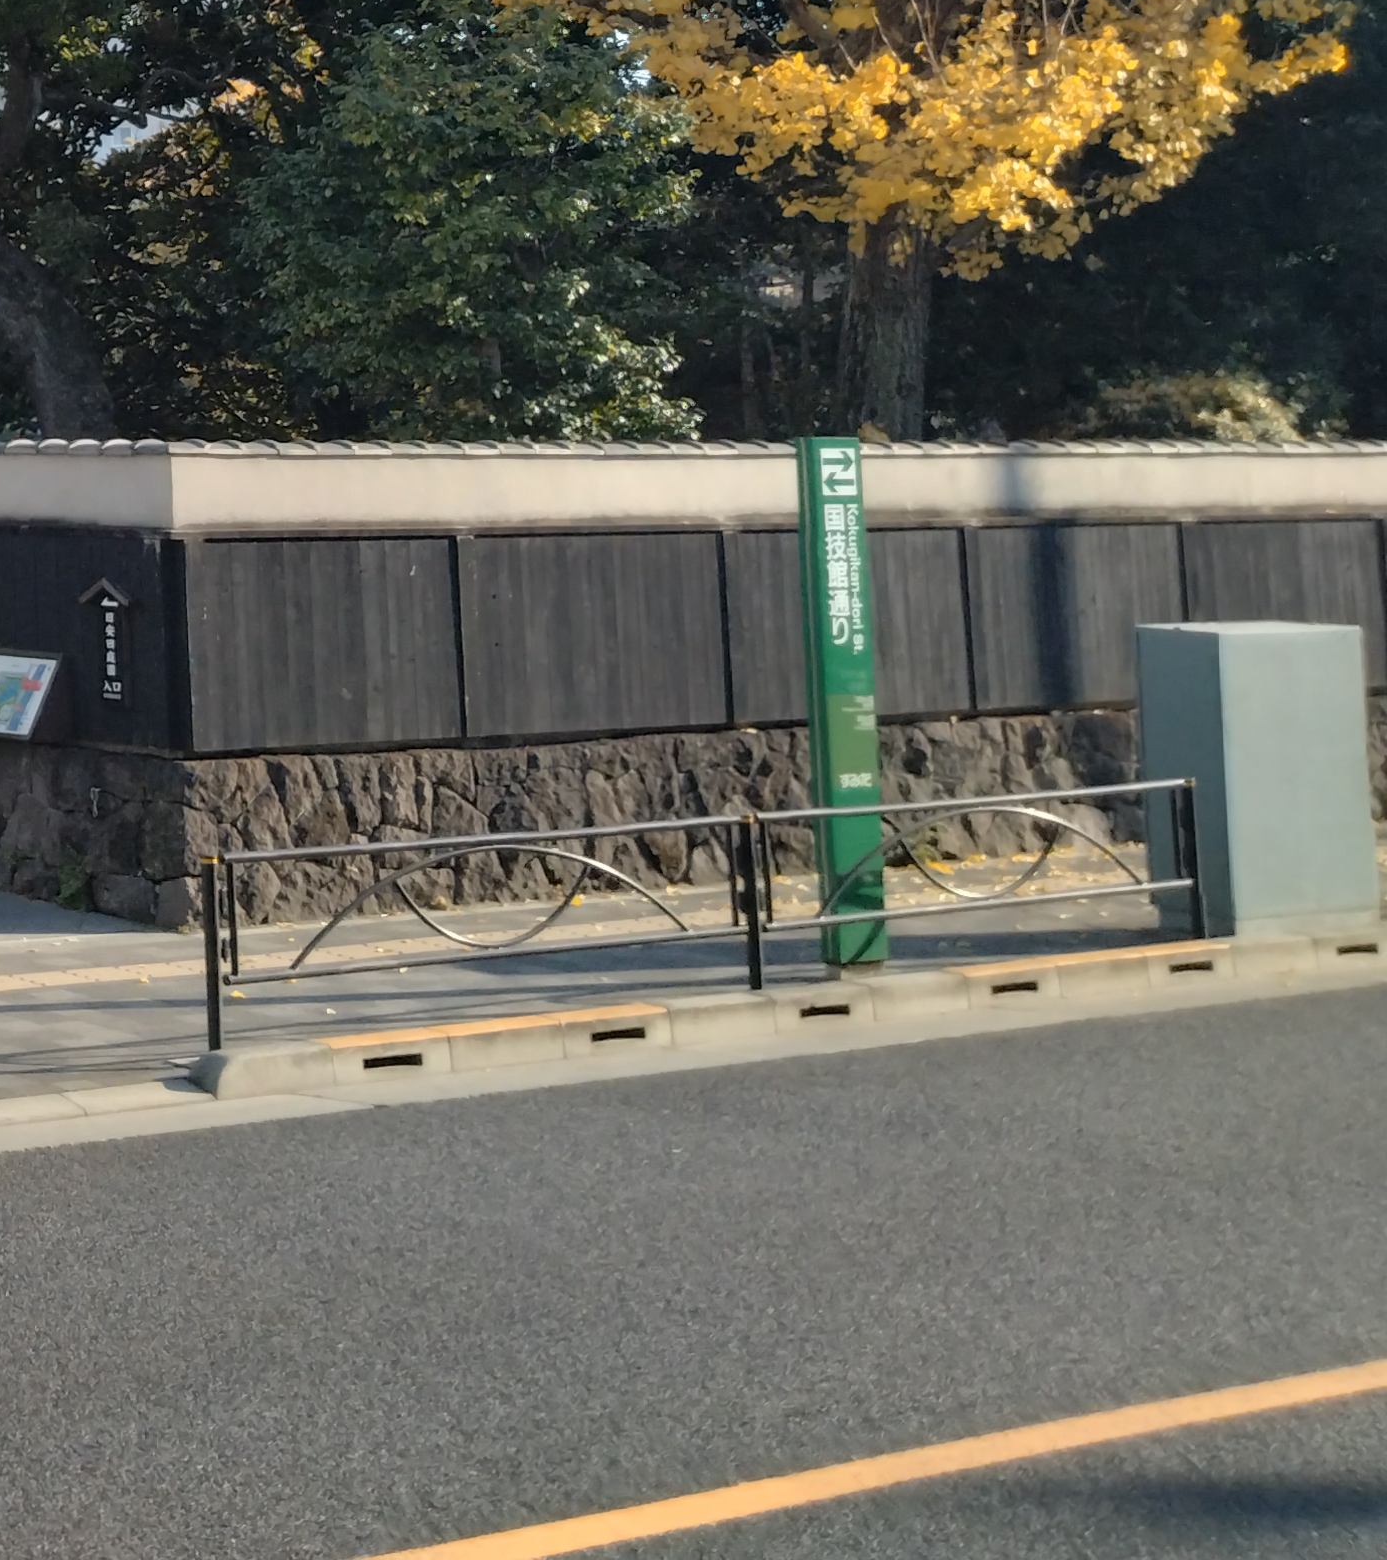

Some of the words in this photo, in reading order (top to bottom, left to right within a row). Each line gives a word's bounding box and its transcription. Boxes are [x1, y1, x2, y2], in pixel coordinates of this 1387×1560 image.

[823, 503, 851, 645] 国技館通り
[846, 503, 864, 630] Kokugikan-dori
